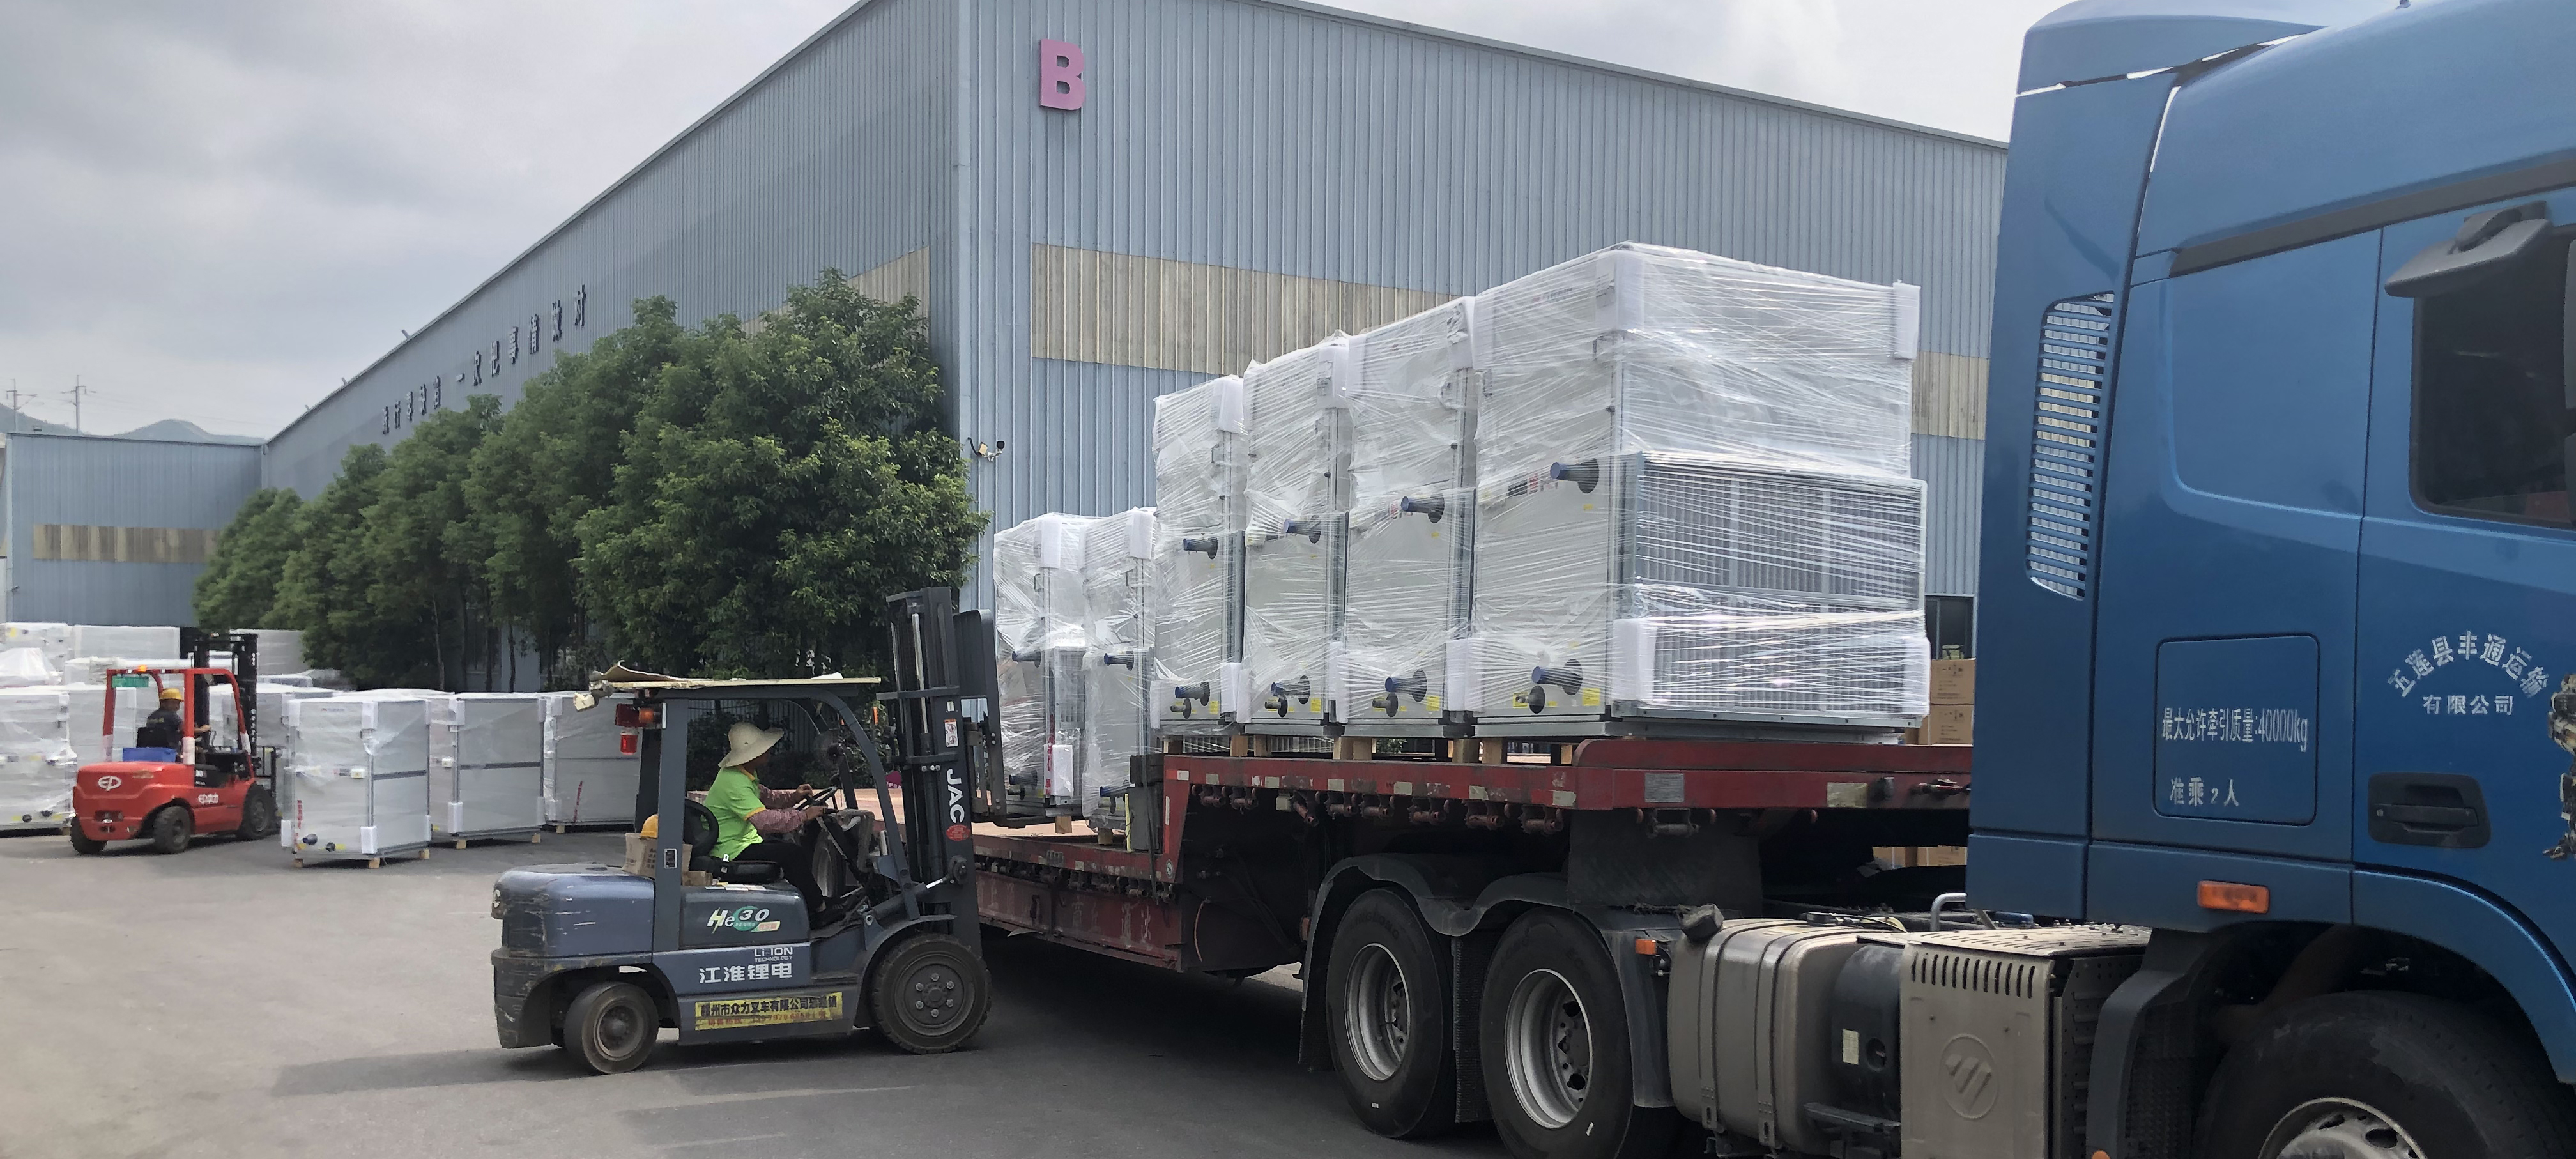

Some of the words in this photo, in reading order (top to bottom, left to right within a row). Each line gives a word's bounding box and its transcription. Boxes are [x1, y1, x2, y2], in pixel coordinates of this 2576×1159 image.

[1039, 38, 1085, 111] B
[2423, 694, 2513, 716] 有限公司
[98, 776, 121, 792] EP
[947, 768, 965, 824] JAC
[739, 909, 770, 921] 30
[754, 946, 793, 957] Li-ION
[699, 962, 793, 984] 江淮锂电
